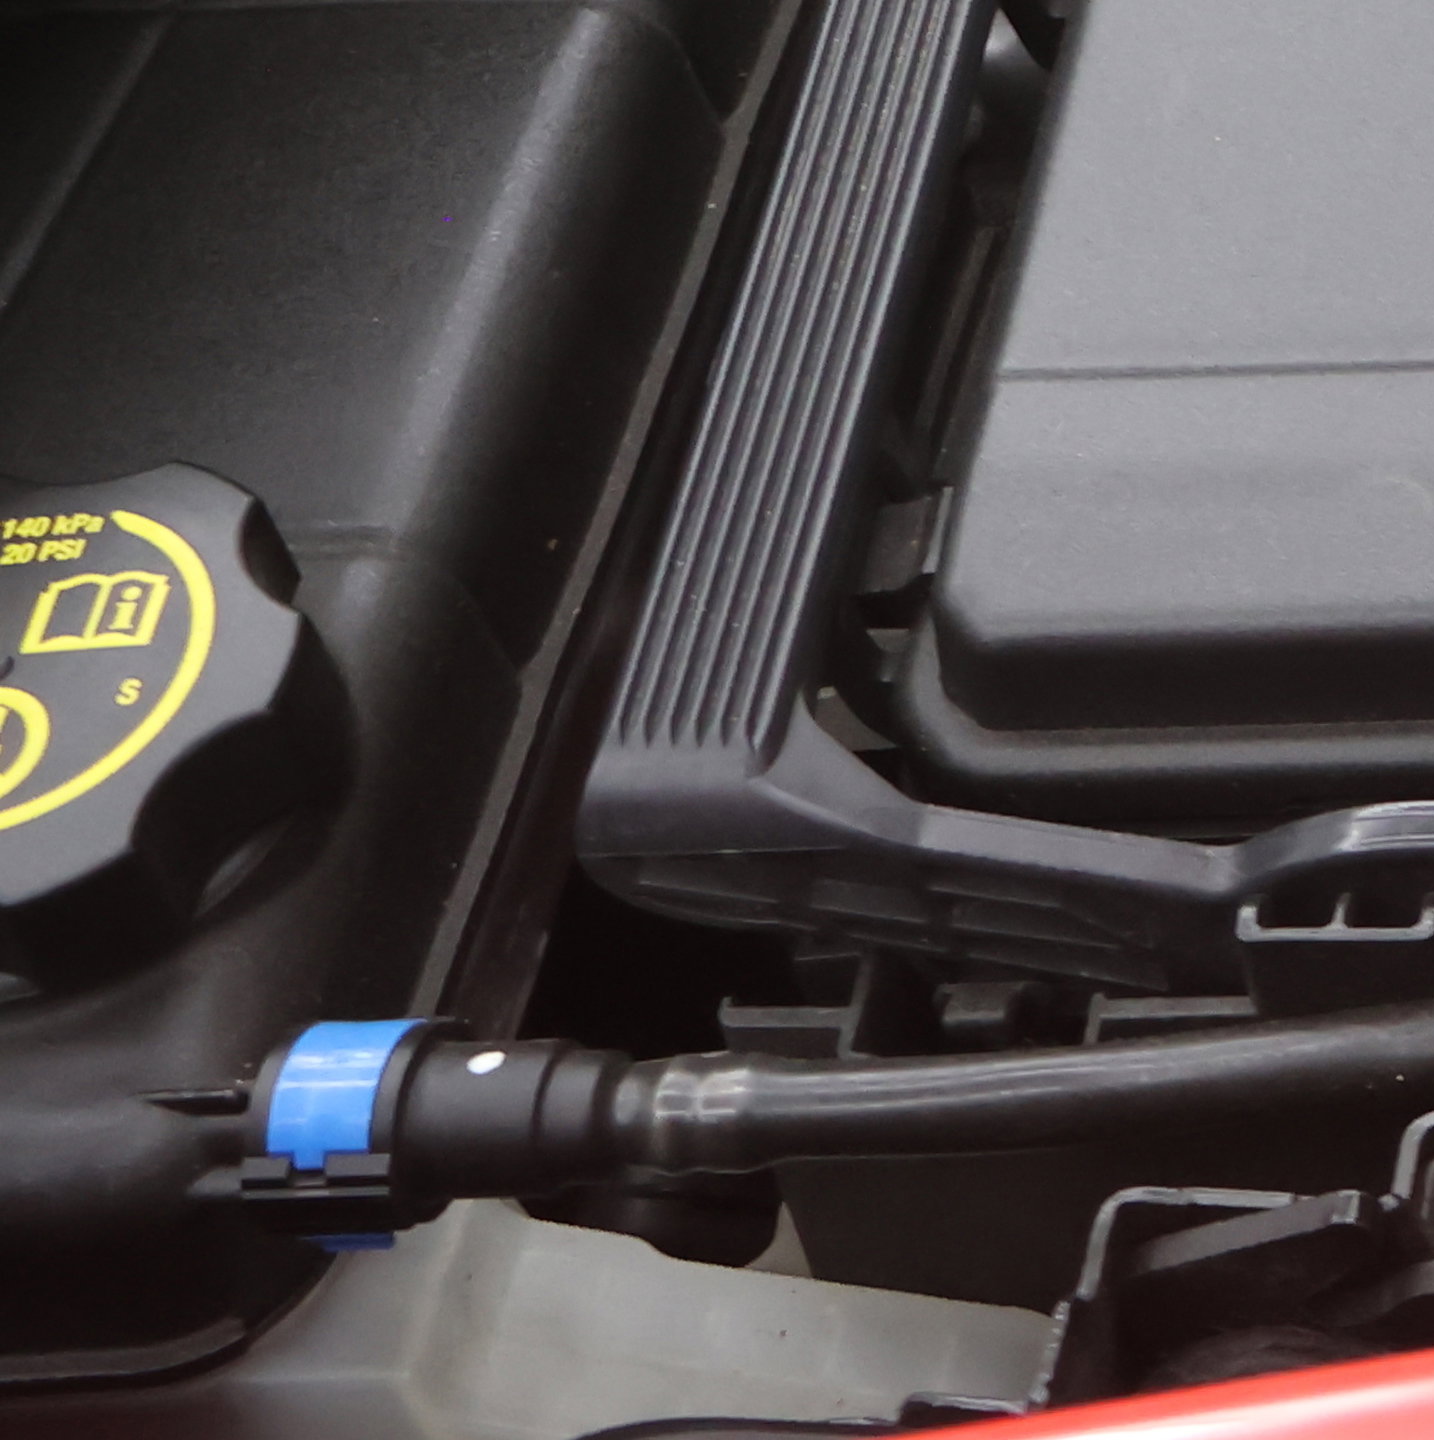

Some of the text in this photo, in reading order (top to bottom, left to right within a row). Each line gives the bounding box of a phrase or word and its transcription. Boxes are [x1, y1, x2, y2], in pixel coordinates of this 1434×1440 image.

[2, 513, 106, 540] 140 kPa
[0, 538, 88, 566] 20 PSI
